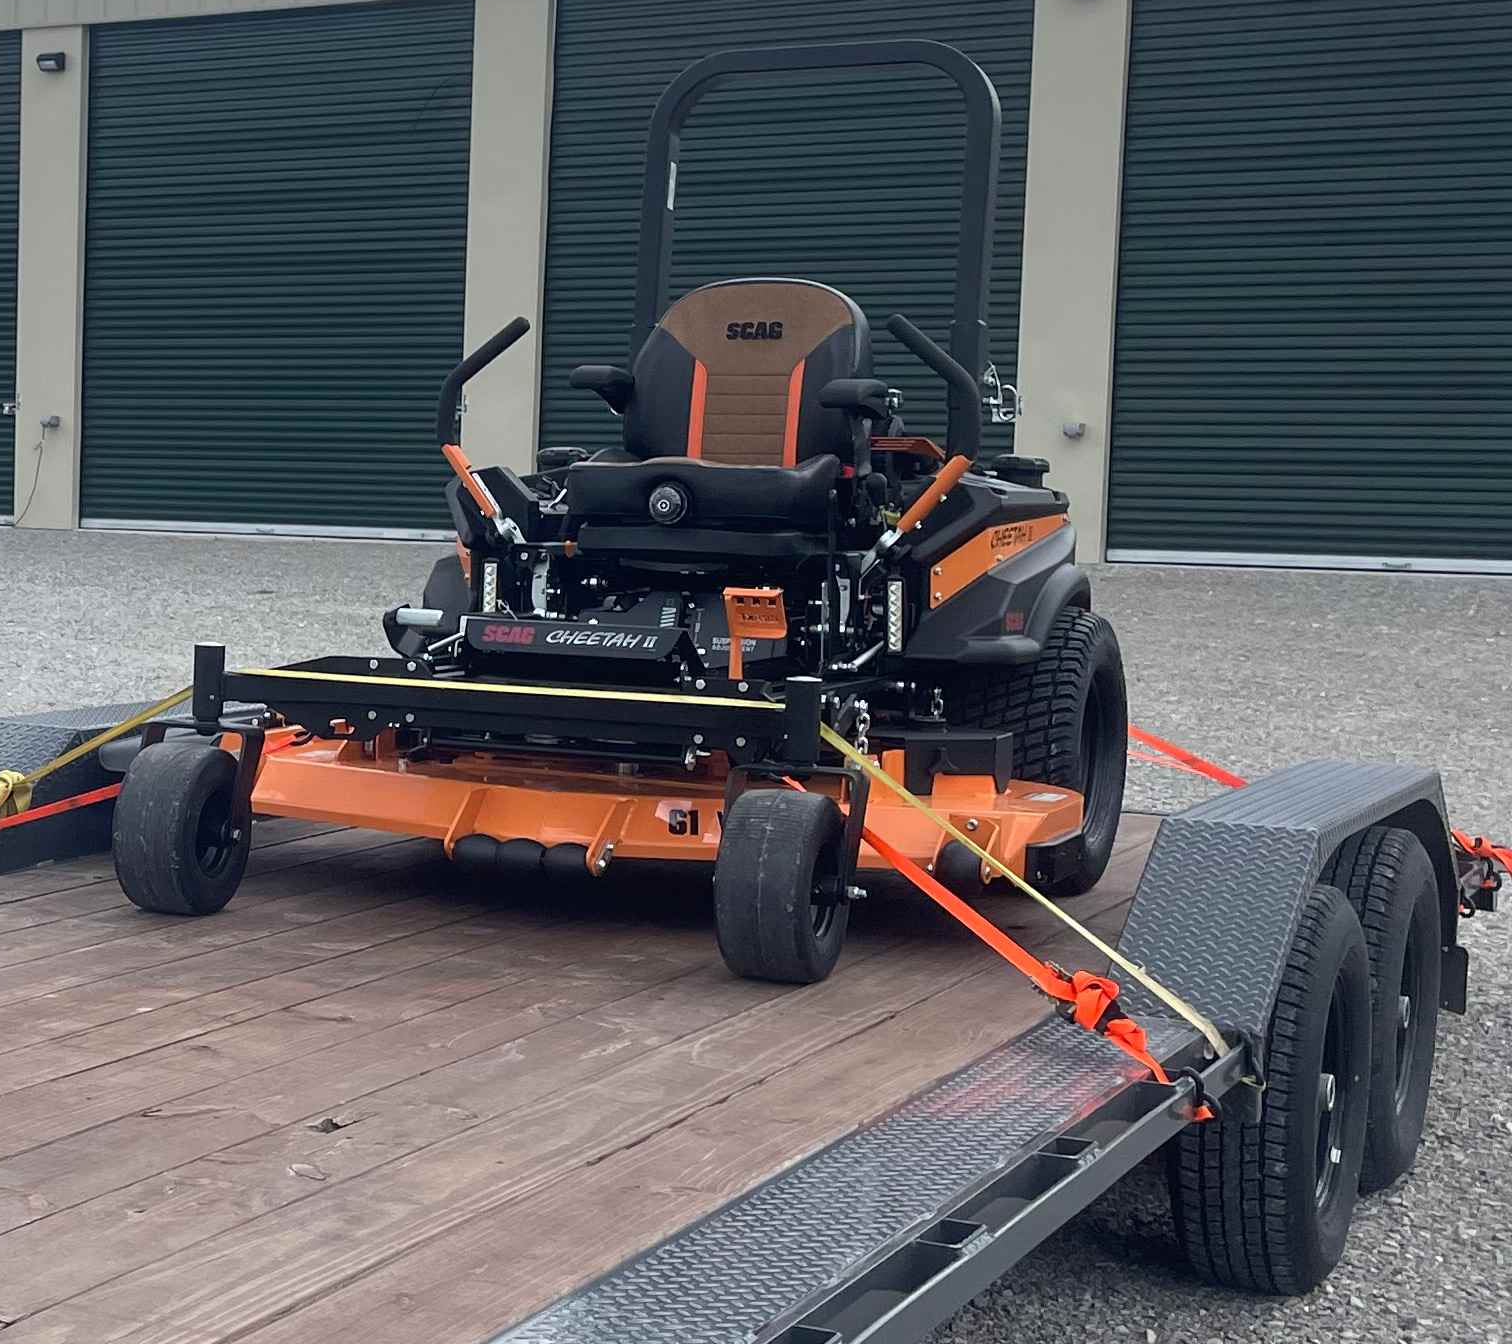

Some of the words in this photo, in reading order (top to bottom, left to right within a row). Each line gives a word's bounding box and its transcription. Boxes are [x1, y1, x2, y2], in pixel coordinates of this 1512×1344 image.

[726, 321, 783, 340] SCAG
[481, 624, 535, 645] SCAG
[545, 629, 641, 649] CHEETAH
[642, 635, 658, 649] II
[668, 809, 699, 836] 61
